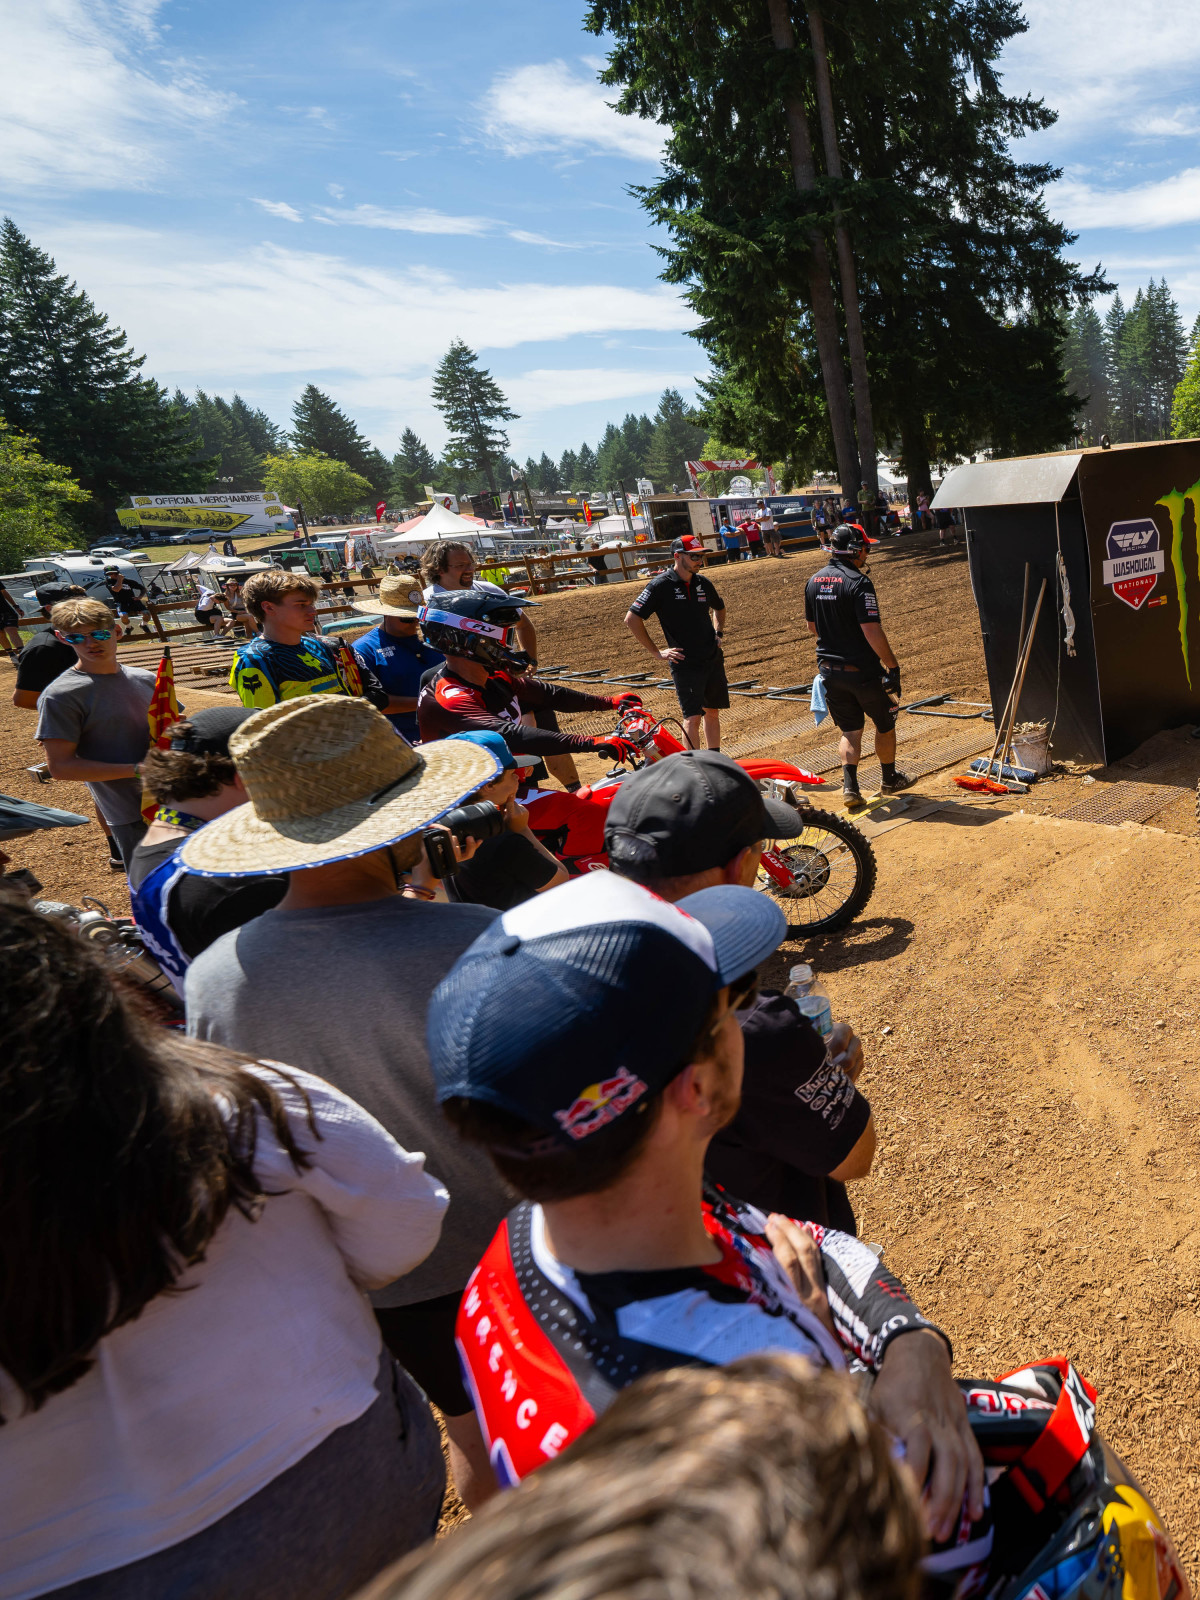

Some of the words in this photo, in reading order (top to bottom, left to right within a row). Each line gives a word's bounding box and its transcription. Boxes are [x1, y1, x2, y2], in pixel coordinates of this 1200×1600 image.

[154, 496, 198, 506] OFFICIAL
[199, 494, 262, 505] MERCHANDISE
[1111, 529, 1155, 548] FLY
[1112, 556, 1157, 578] WASHOUGAL
[813, 576, 843, 584] HONDA
[1118, 578, 1153, 591] NATIONAL
[472, 622, 496, 634] FLY
